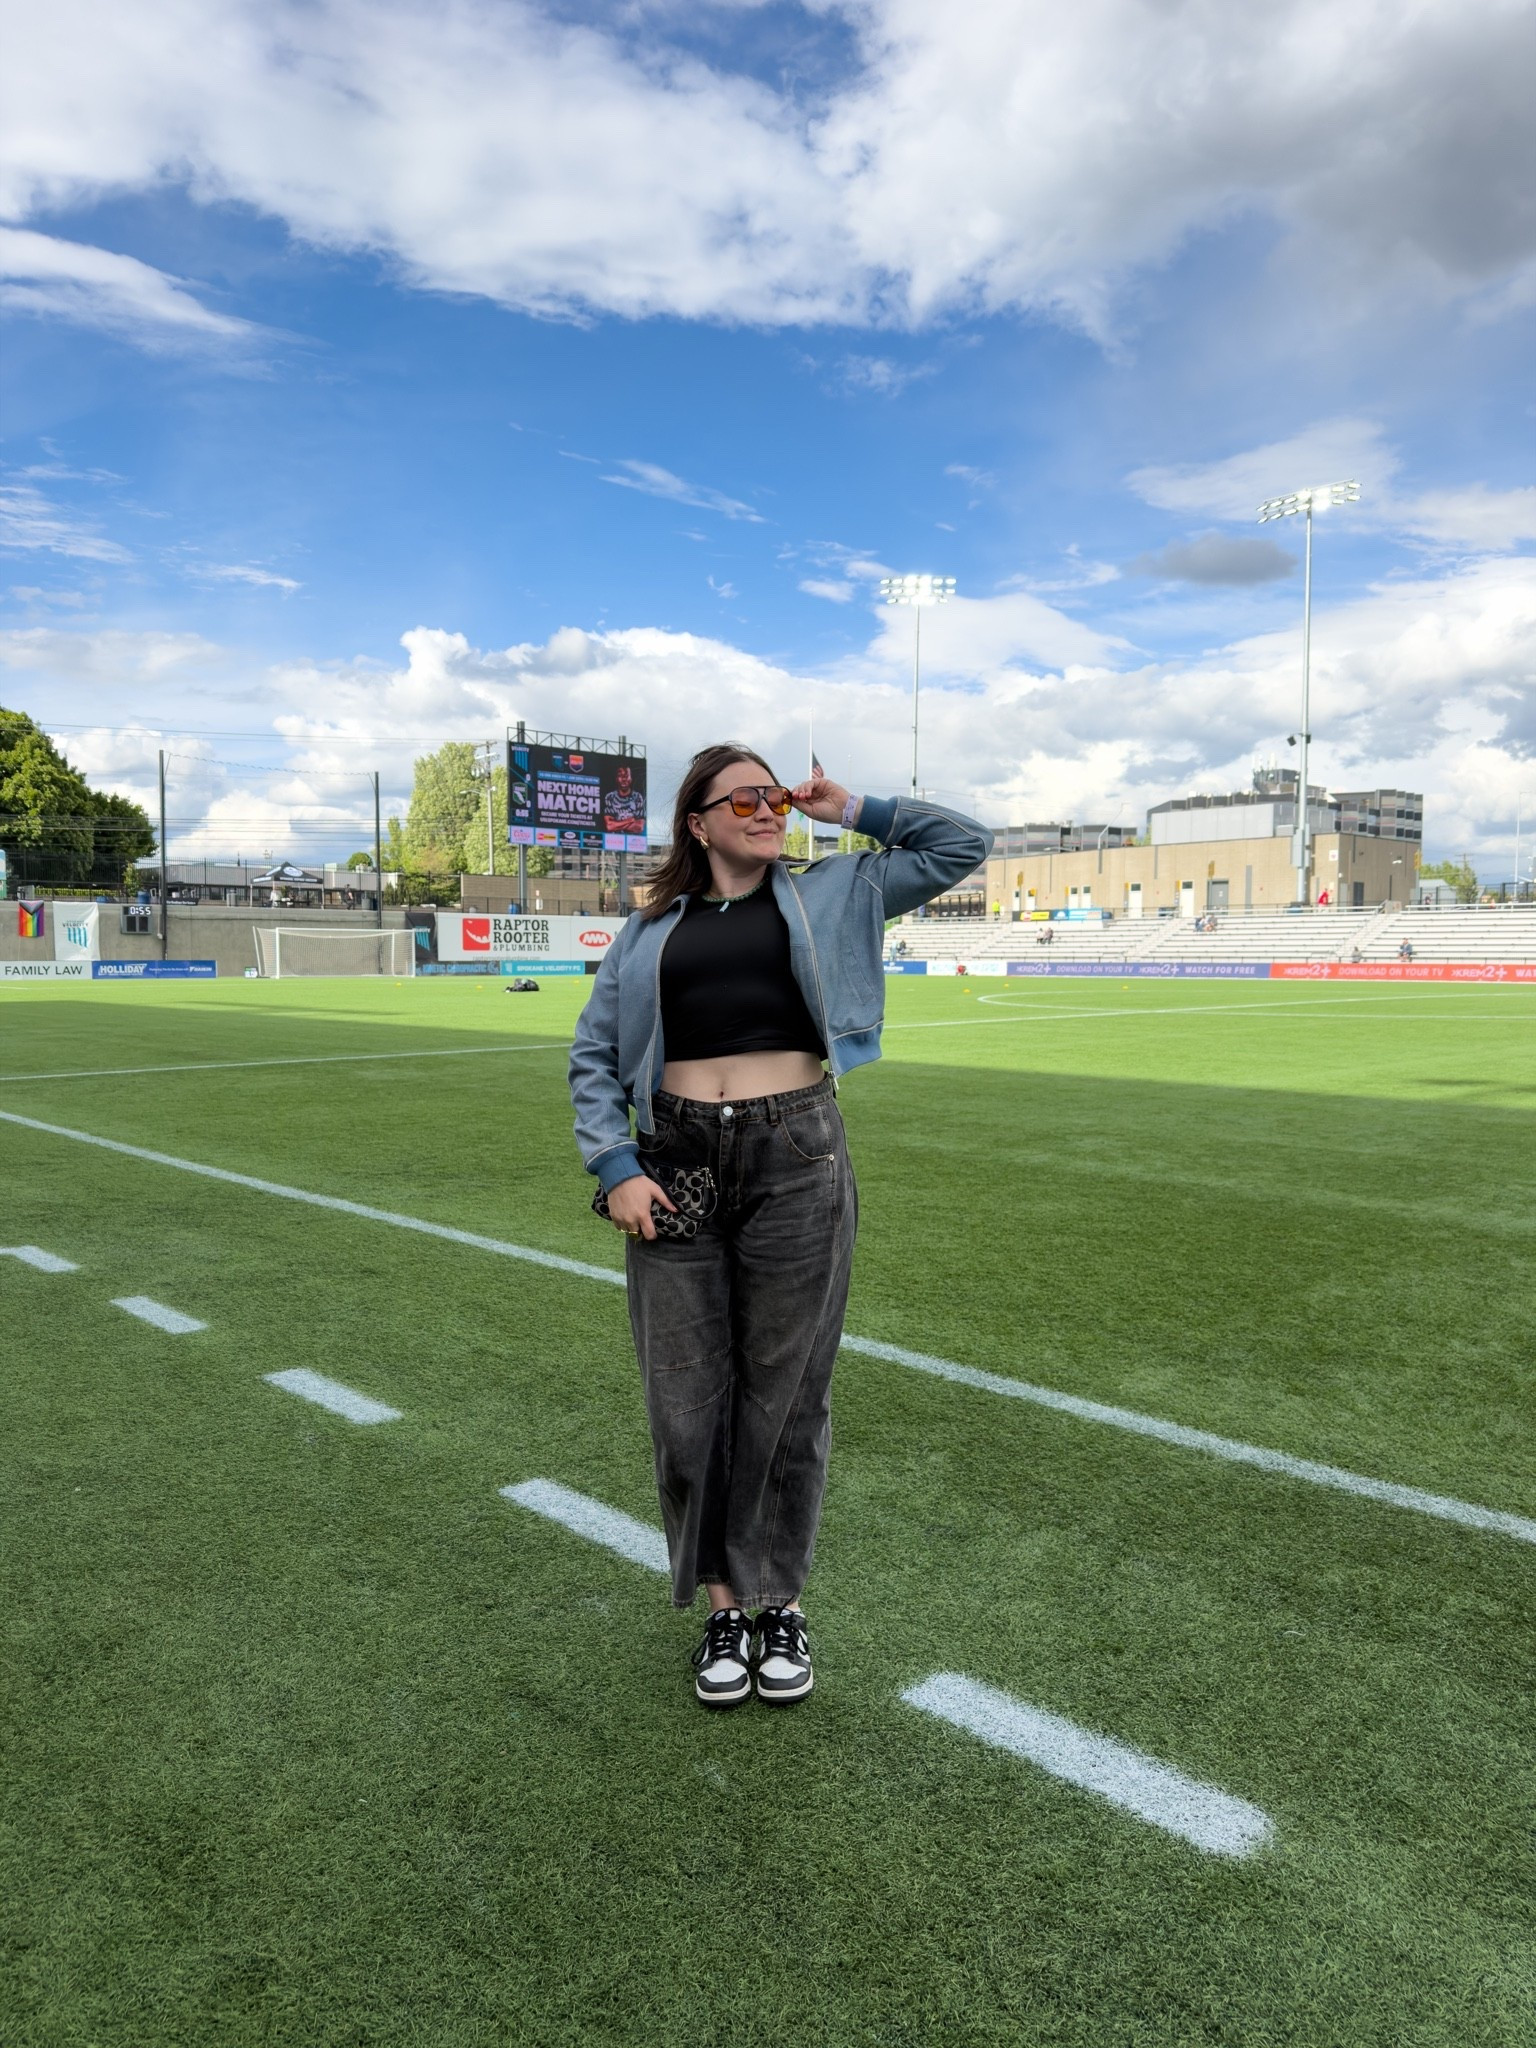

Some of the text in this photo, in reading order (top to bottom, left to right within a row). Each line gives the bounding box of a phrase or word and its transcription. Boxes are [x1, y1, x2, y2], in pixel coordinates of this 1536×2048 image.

[537, 780, 567, 794] NEXT
[568, 783, 600, 797] HOME
[537, 792, 601, 815] MATCH
[130, 906, 151, 915] 0:55
[493, 919, 549, 931] RAPTOR
[493, 931, 549, 943] ROOTER
[5, 966, 83, 975] FAMILY LAW
[100, 964, 146, 974] HOLLIDAY
[1185, 966, 1213, 974] WATCH
[1215, 966, 1233, 974] FOR
[1234, 966, 1255, 975] FREE
[1339, 967, 1387, 975] DOWNLOAD
[1389, 967, 1402, 976] ON
[1405, 967, 1429, 976] YOUR
[1432, 967, 1444, 976] TV
